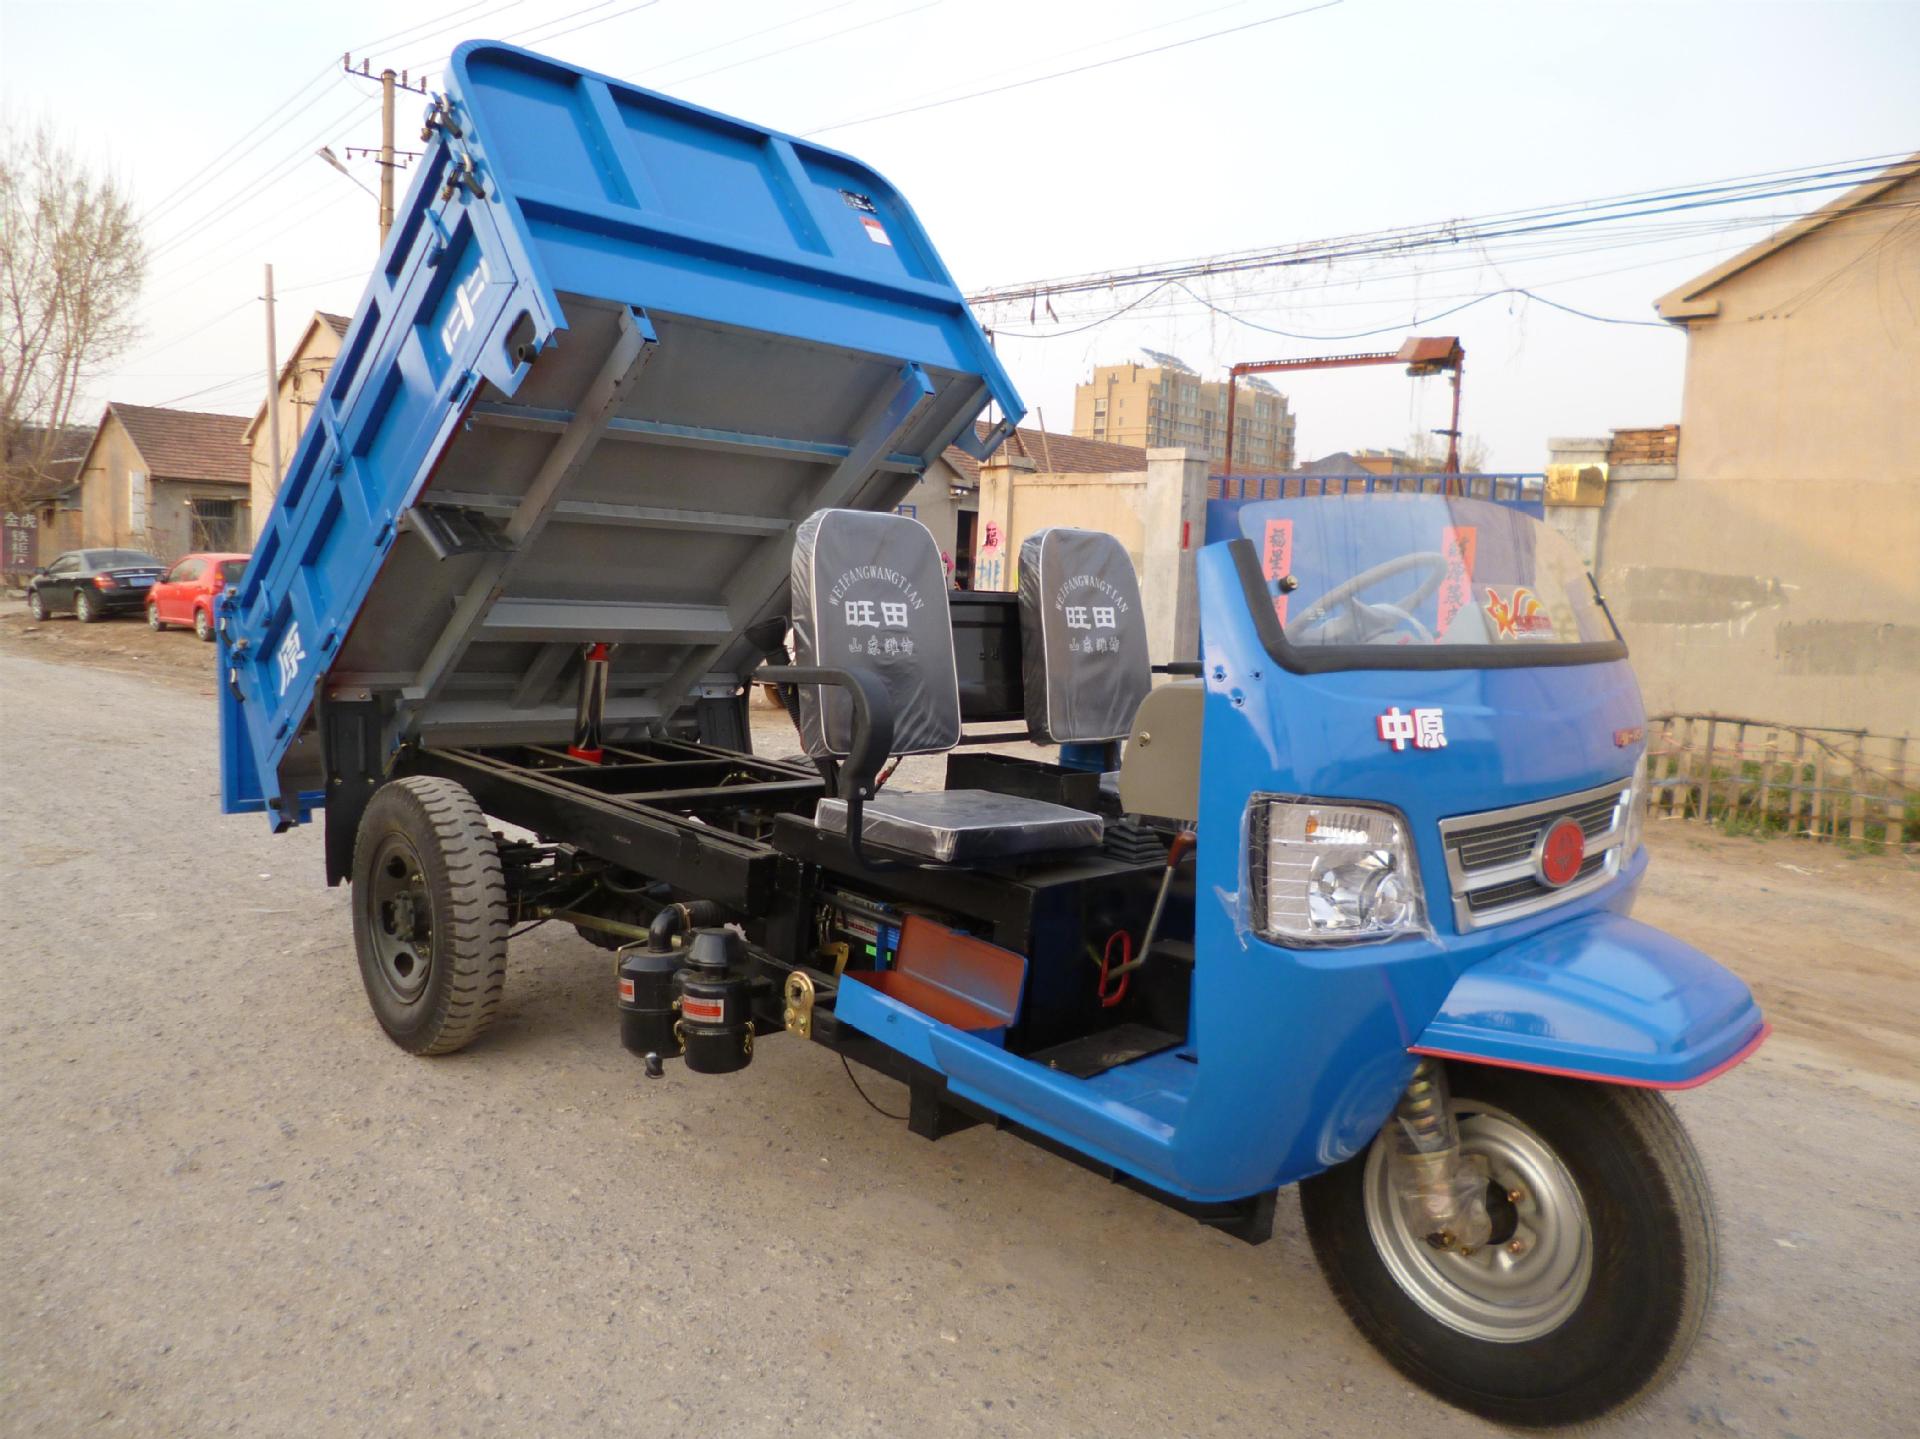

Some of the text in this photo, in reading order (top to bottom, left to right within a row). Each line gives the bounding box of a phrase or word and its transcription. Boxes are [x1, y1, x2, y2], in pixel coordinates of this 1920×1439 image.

[442, 257, 490, 356] 中
[829, 565, 924, 610] WEIFANGWANGTIAN
[1055, 575, 1129, 613] WEIFANGWANGTIAN
[845, 600, 909, 628] 旺田
[1065, 606, 1116, 630] 旺田
[1376, 706, 1448, 752] 中原
